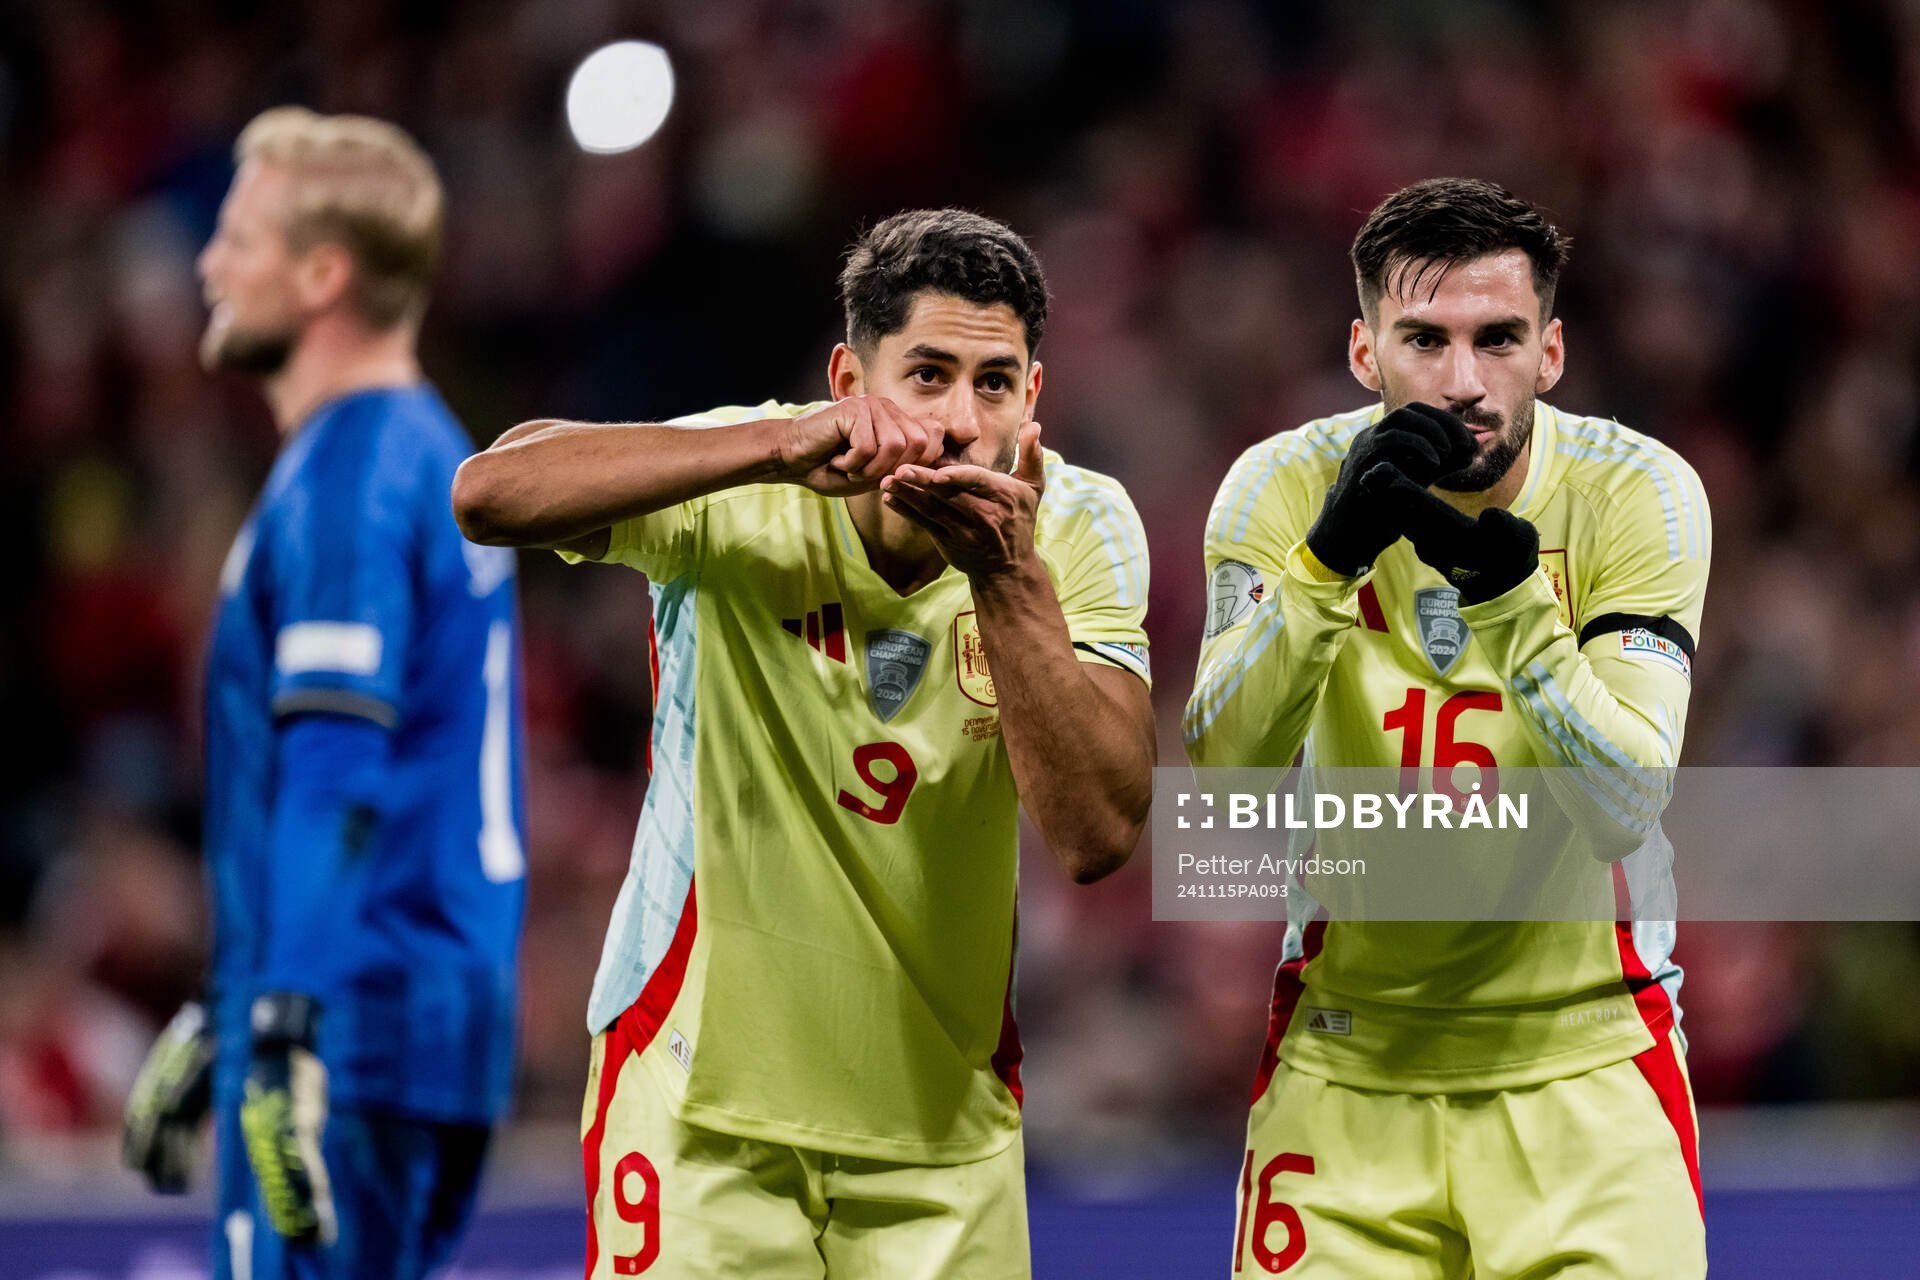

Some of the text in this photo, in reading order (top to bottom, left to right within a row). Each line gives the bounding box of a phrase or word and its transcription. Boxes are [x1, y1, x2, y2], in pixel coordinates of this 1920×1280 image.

[1420, 597, 1457, 609] EUROPE
[1436, 591, 1457, 600] UEFA
[1420, 606, 1460, 618] CHAMPIO
[871, 639, 925, 656] EUROPEAN
[1430, 644, 1456, 656] 2024
[1622, 634, 1690, 666] FOUNDATI
[870, 649, 922, 665] CHAMPIONS
[876, 688, 903, 701] 2024
[1383, 687, 1503, 816] 16
[837, 741, 918, 825] 9
[614, 1151, 660, 1276] 9
[1235, 1150, 1315, 1274] 16
